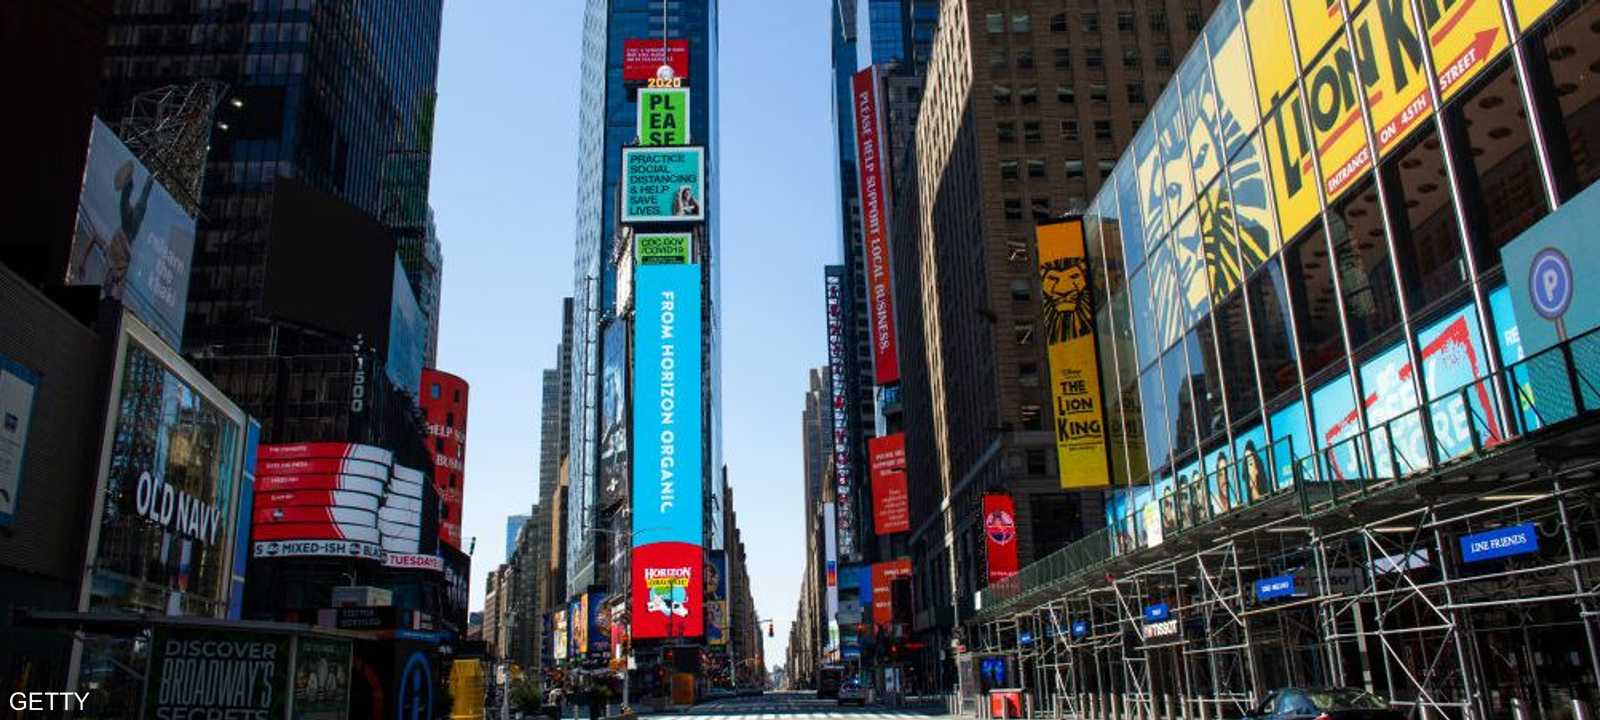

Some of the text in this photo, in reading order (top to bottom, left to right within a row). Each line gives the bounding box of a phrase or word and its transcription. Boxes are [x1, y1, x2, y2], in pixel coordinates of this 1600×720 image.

[648, 78, 681, 88] 2020
[650, 94, 675, 110] PL
[650, 113, 676, 128] EA
[860, 91, 873, 137] PLEASE
[1328, 48, 1476, 190] ENTRANCE ON 45TH STREET
[630, 154, 685, 164] PRACTICE
[864, 139, 875, 172] HELP
[630, 165, 671, 173] SOCIAL
[631, 175, 698, 184] DISTANCING
[631, 185, 670, 194] & HELP
[631, 195, 657, 204] SAVE
[866, 175, 881, 235] SUPPORT
[872, 238, 884, 281] LOCAL
[1543, 269, 1557, 302] P
[1060, 380, 1086, 393] THE
[660, 290, 675, 513] FROM HORIZON ORGANIC
[1057, 396, 1093, 416] LION
[1058, 418, 1102, 441] KING
[136, 471, 221, 545] OLD NAVY
[282, 542, 346, 554] MIXED-ISH
[1471, 533, 1528, 553] LINE FRIENDS
[644, 566, 692, 580] HORIZON
[165, 639, 277, 659] DISCOVER
[159, 658, 275, 708] BROADWAY'S
